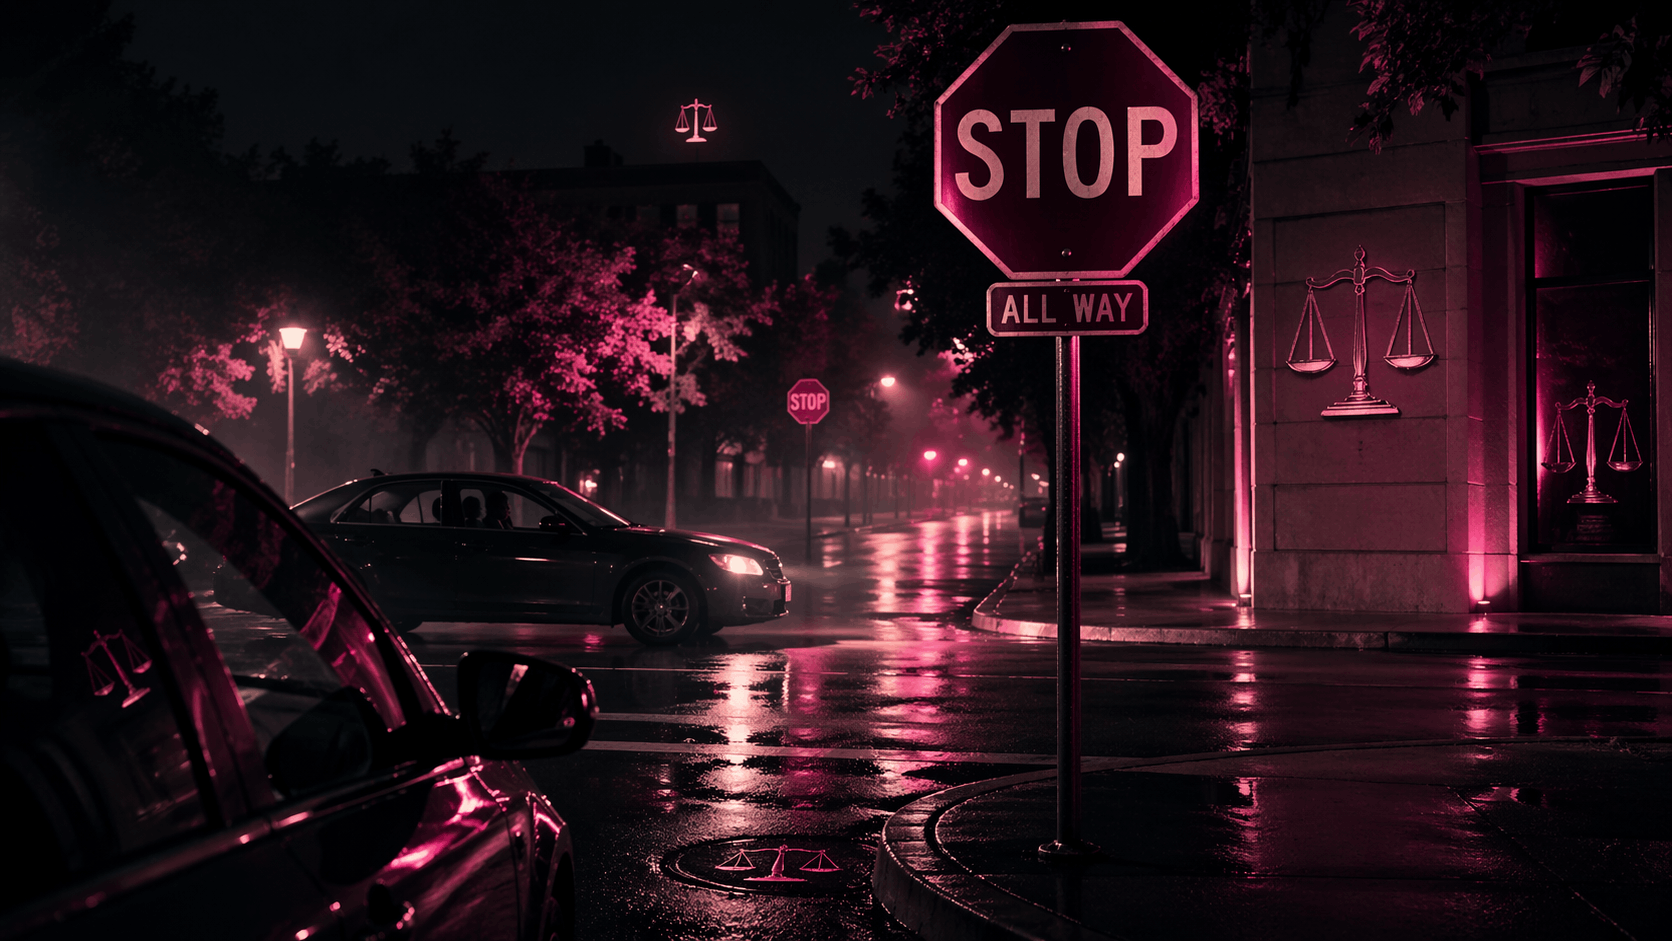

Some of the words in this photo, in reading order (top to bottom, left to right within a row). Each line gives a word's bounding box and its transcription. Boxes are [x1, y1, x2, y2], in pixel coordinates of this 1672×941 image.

[955, 106, 1177, 201] STOP
[1001, 294, 1056, 324] ALL
[1072, 293, 1133, 322] WAY
[790, 393, 827, 411] STOP
